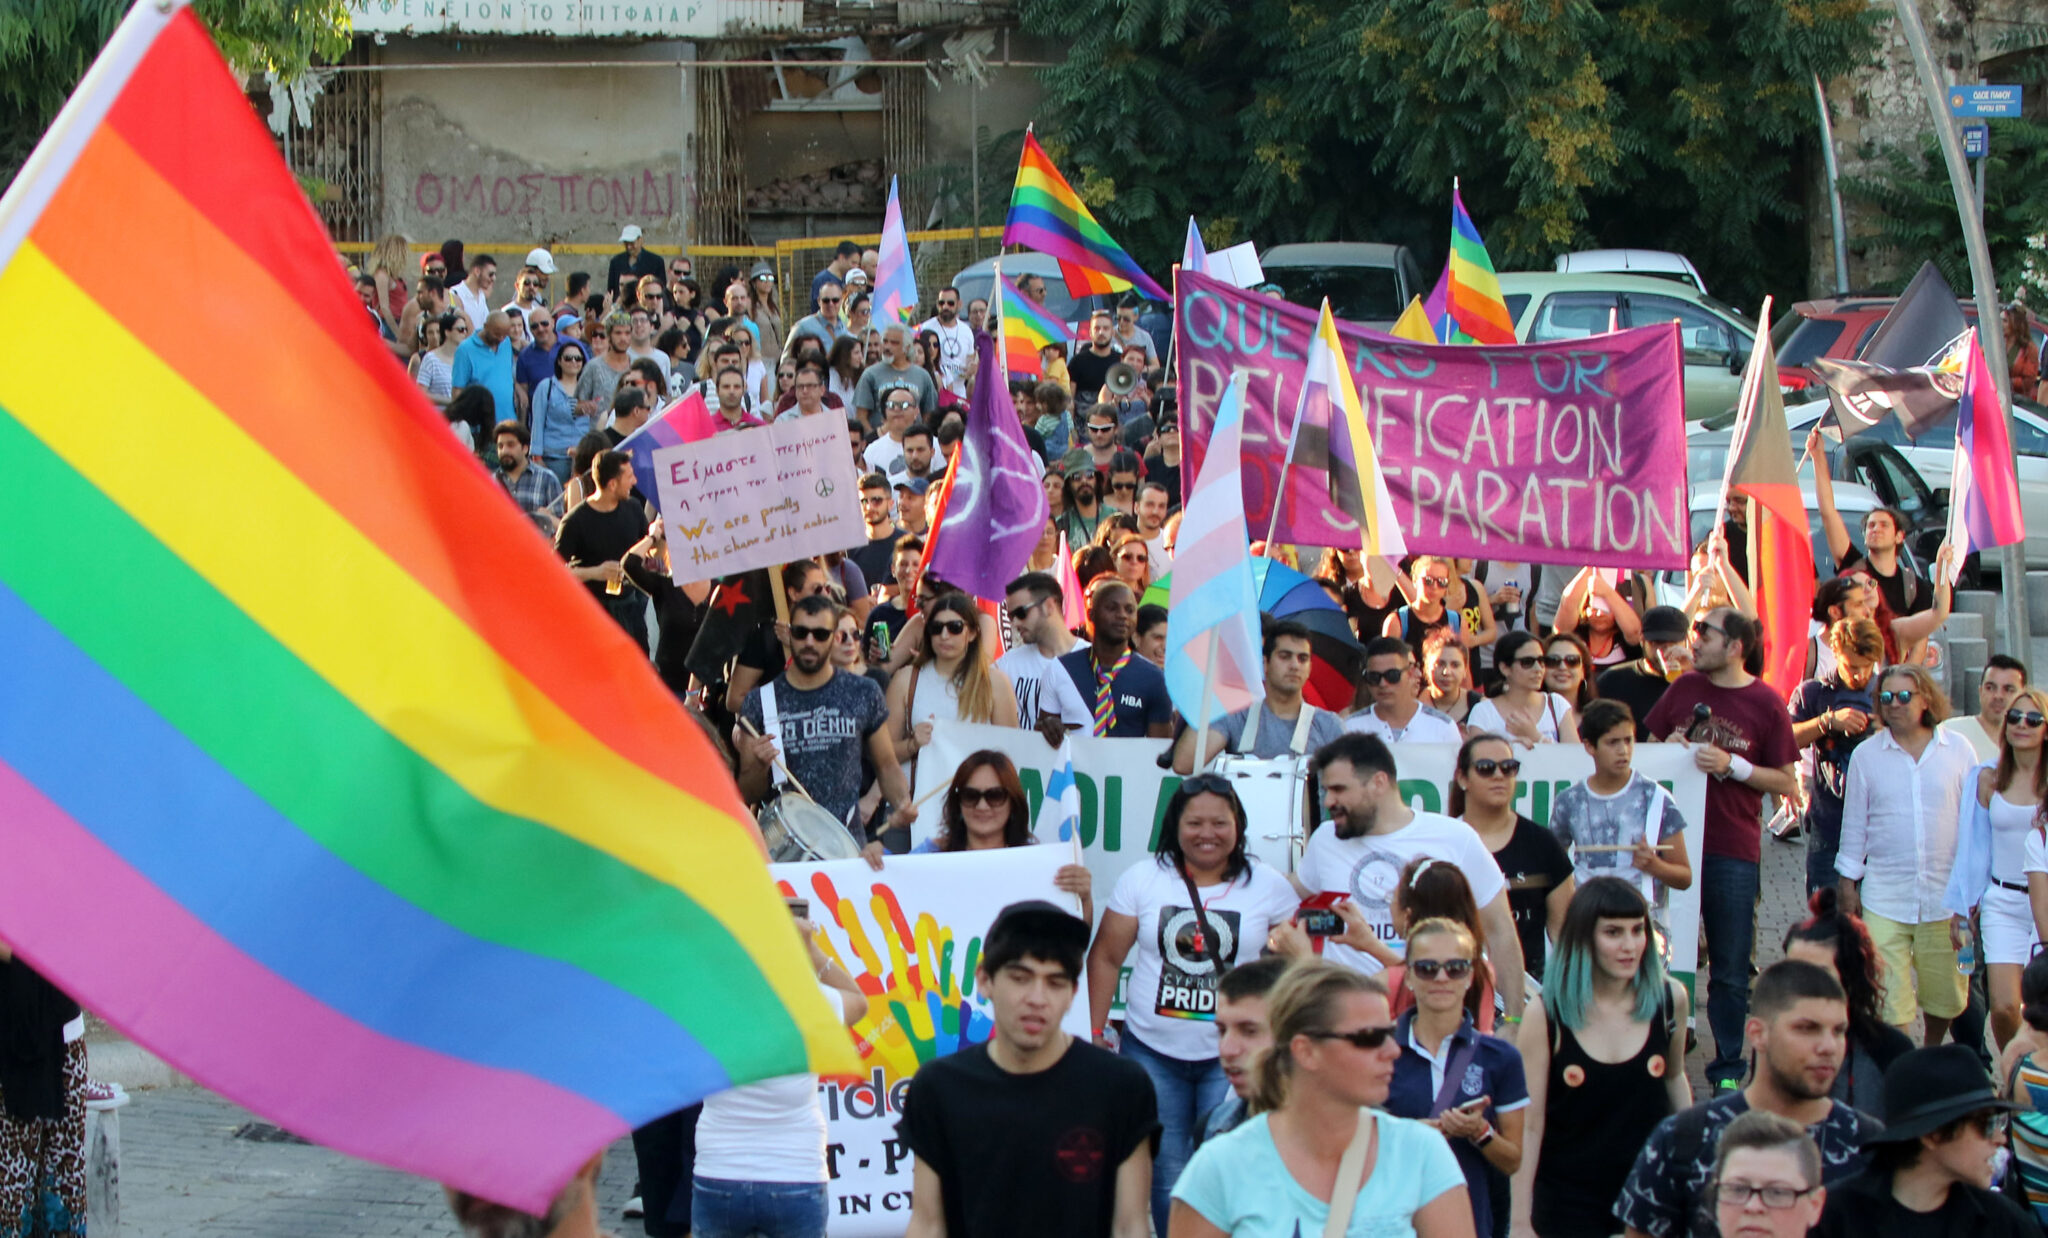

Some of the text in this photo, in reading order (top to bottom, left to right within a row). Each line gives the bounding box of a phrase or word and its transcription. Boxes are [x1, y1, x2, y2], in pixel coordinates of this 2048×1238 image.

[1184, 290, 1613, 398] QUERS FOR
[678, 517, 714, 541] We
[724, 514, 750, 530] are
[691, 544, 719, 566] the
[764, 527, 777, 543] of
[1120, 693, 1142, 708] HBA
[802, 717, 857, 740] DENIM
[838, 1193, 871, 1216] IN
